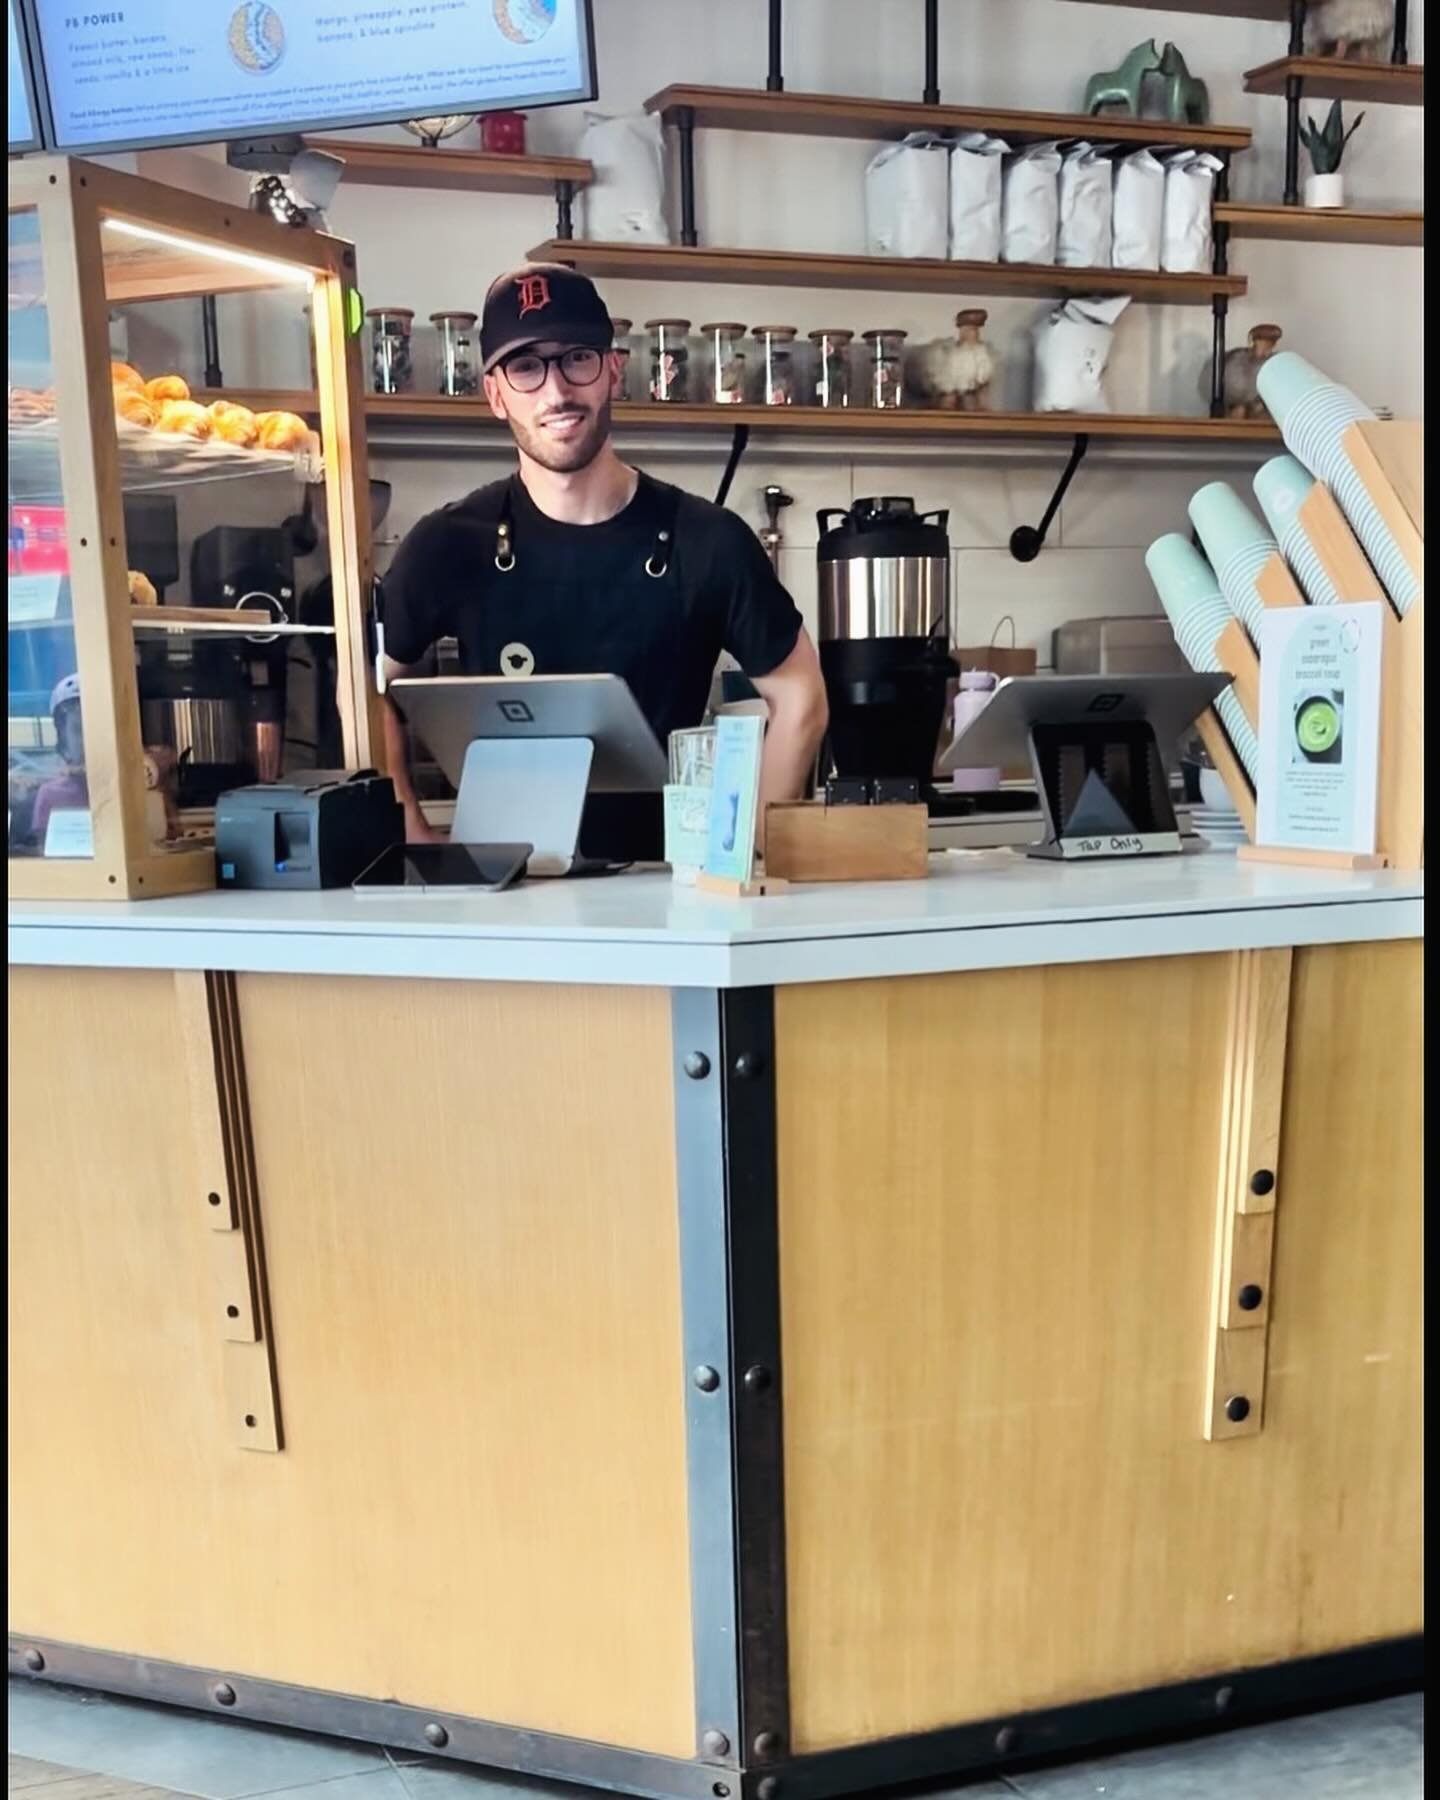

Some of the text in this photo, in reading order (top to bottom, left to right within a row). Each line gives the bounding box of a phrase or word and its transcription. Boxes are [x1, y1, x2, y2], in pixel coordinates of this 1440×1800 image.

[83, 11, 124, 26] POWER
[515, 275, 551, 320] D
[1109, 836, 1144, 852] Only
